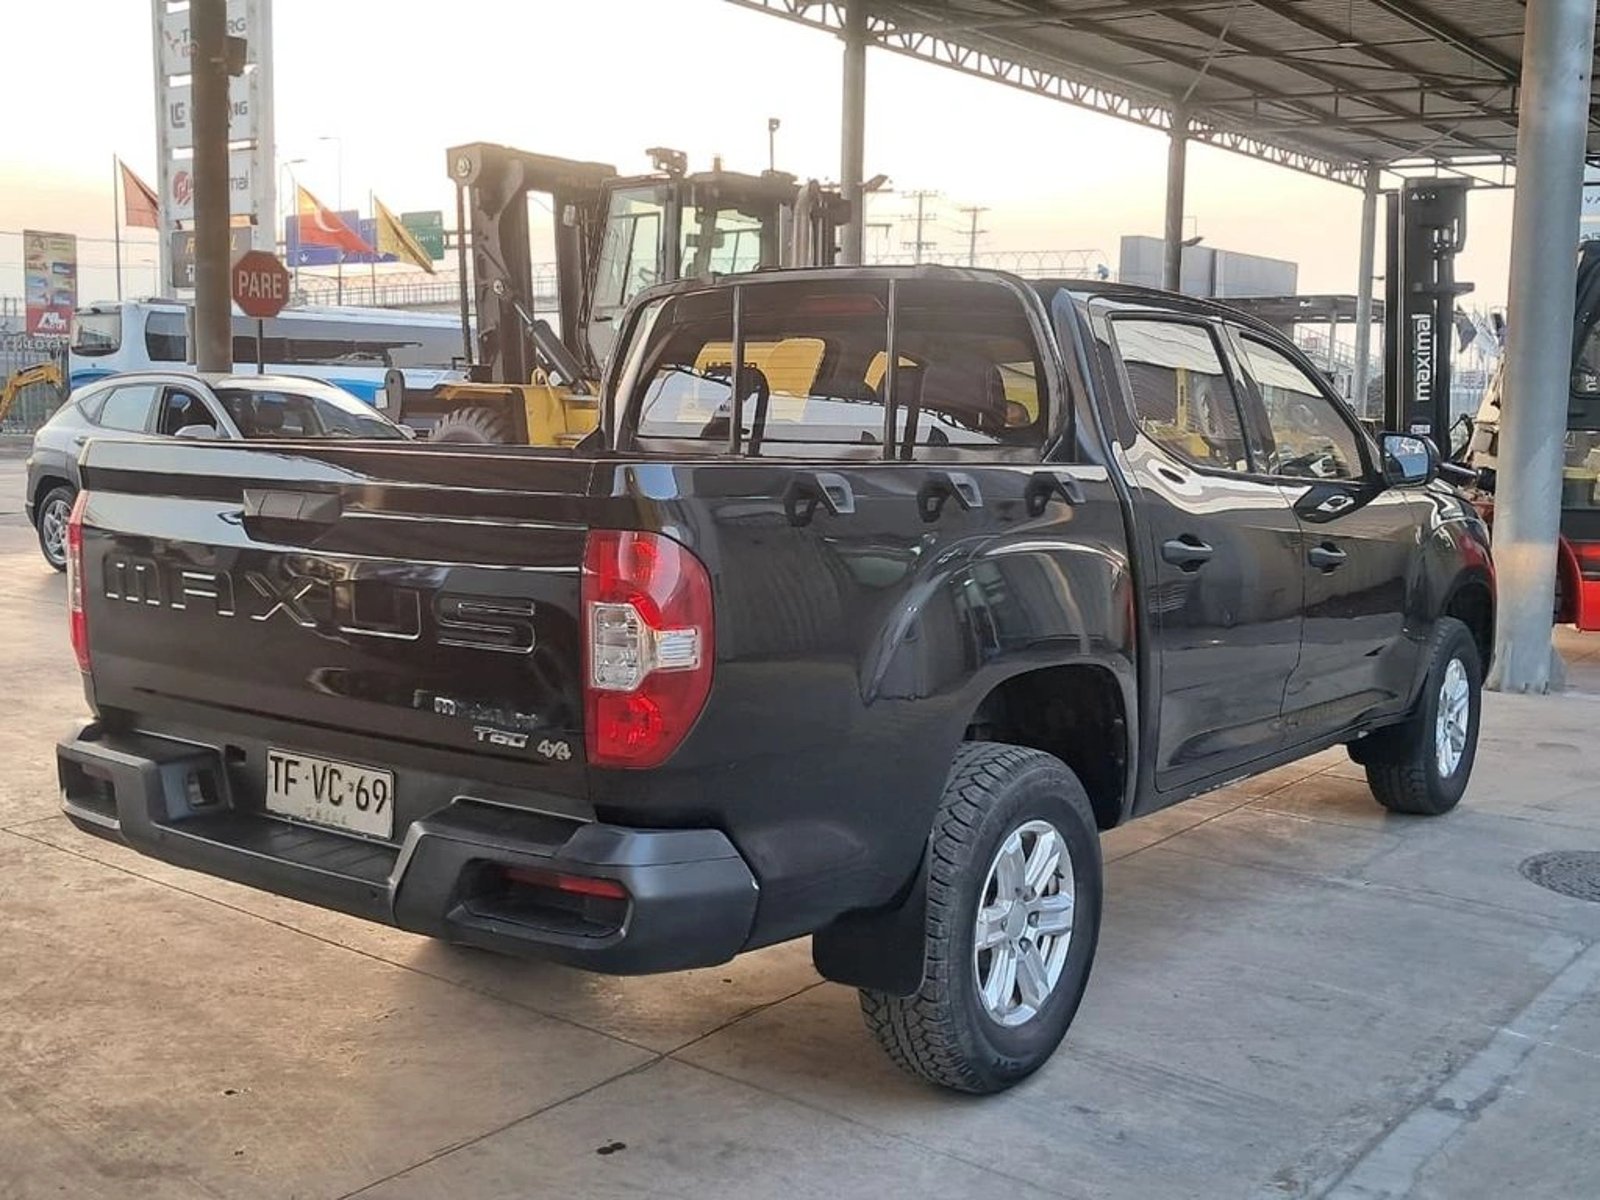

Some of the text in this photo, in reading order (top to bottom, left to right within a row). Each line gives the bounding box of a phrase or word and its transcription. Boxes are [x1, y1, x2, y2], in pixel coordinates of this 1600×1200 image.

[238, 270, 283, 299] PARE
[1411, 313, 1432, 401] maximal
[103, 552, 537, 655] MAXUS
[269, 755, 387, 815] TF VC 69
